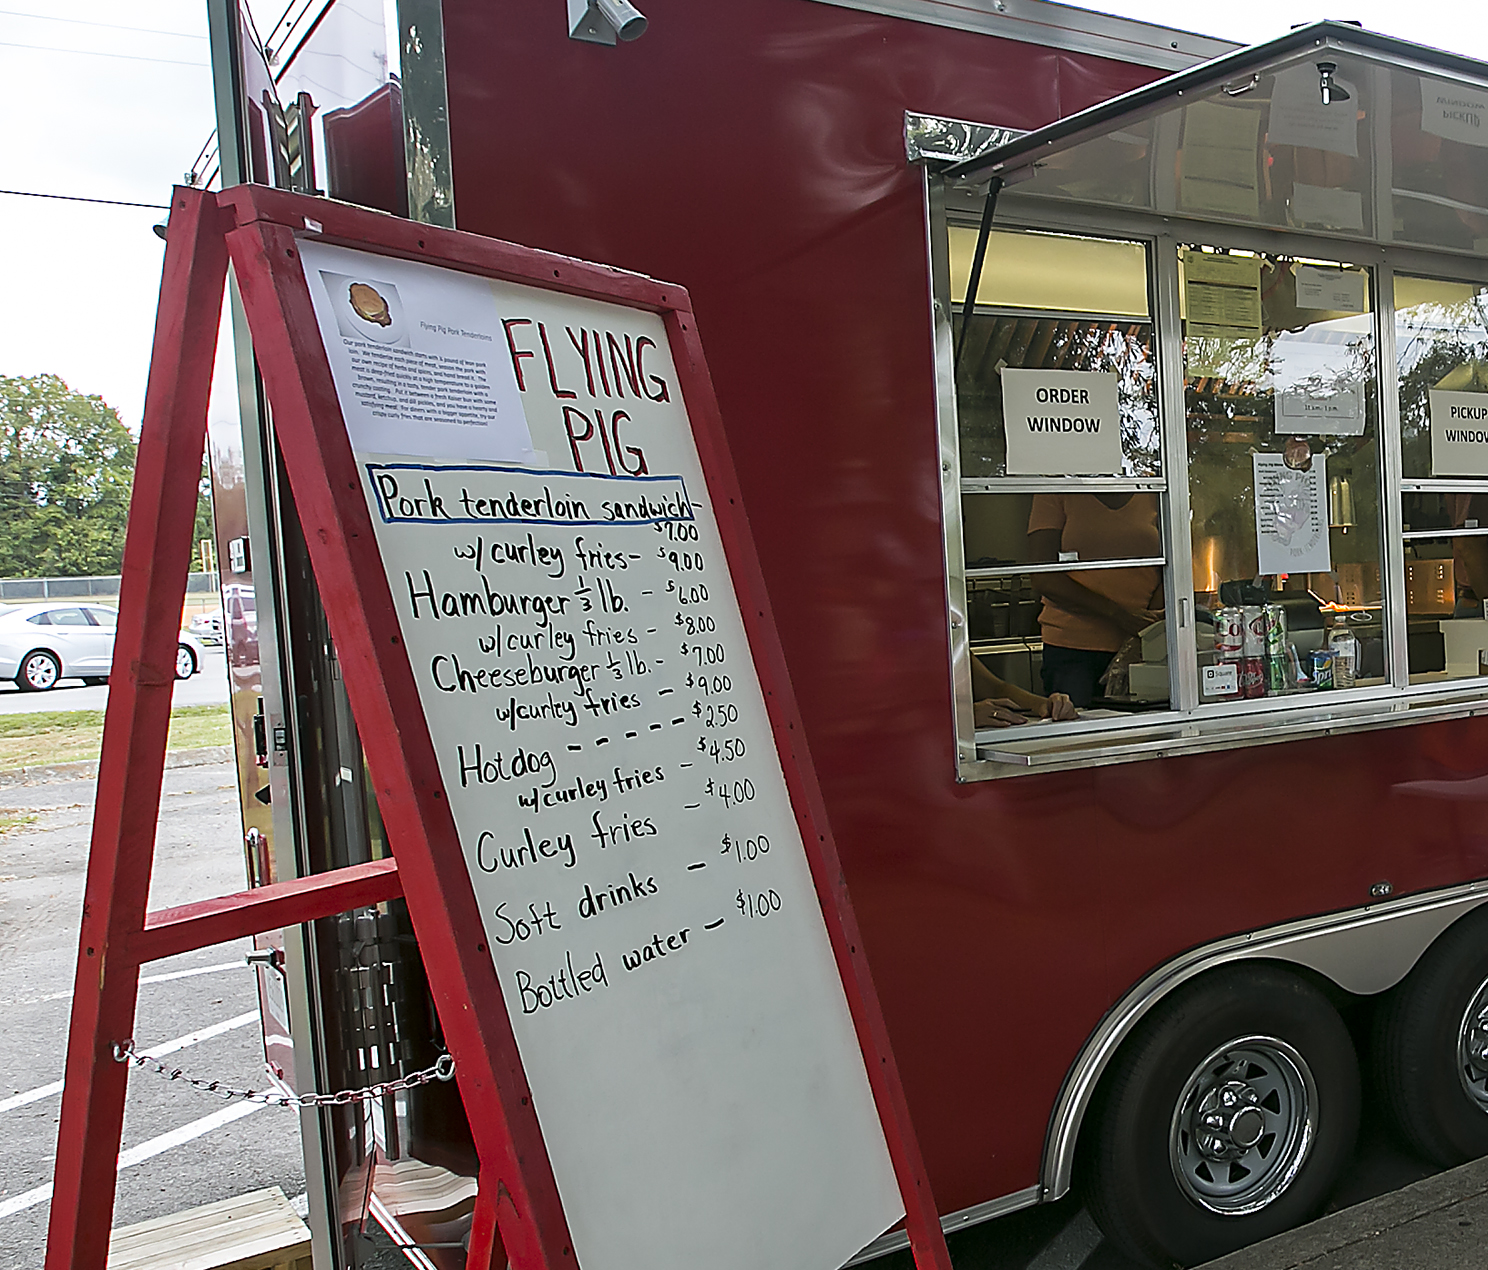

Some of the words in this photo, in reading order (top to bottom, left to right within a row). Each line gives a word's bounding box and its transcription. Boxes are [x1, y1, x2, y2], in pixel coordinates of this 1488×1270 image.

[420, 321, 436, 332] Flying
[437, 325, 446, 334] Pig
[447, 327, 459, 336] Pork
[460, 329, 492, 341] Tenderloins
[501, 318, 670, 403] FLYING
[1036, 388, 1089, 404] ORDER
[1450, 406, 1488, 420] PICKUP
[563, 405, 648, 476] PIG
[1026, 416, 1101, 433] WINDOW
[377, 474, 451, 519] Pork
[459, 487, 591, 520] tenderloin
[405, 569, 571, 628] Hamburger
[665, 579, 709, 604] $6.00
[582, 619, 638, 647] fries
[674, 611, 716, 635] $8.00
[431, 652, 600, 696] Cheeseburger
[680, 642, 725, 666] $7.00
[583, 688, 641, 717] fries
[685, 672, 732, 696] $9.00
[691, 700, 739, 728] $2.50
[613, 764, 665, 794] fries
[697, 736, 746, 764] $4.50
[476, 827, 577, 874] Curley
[591, 810, 658, 848] fries
[704, 777, 755, 809] $4.00
[495, 901, 562, 945] Soft
[578, 872, 659, 919] drinks
[720, 833, 770, 863] $1.00
[515, 950, 609, 1014] Bottled
[622, 928, 691, 971] water
[735, 888, 782, 918] $1.00
